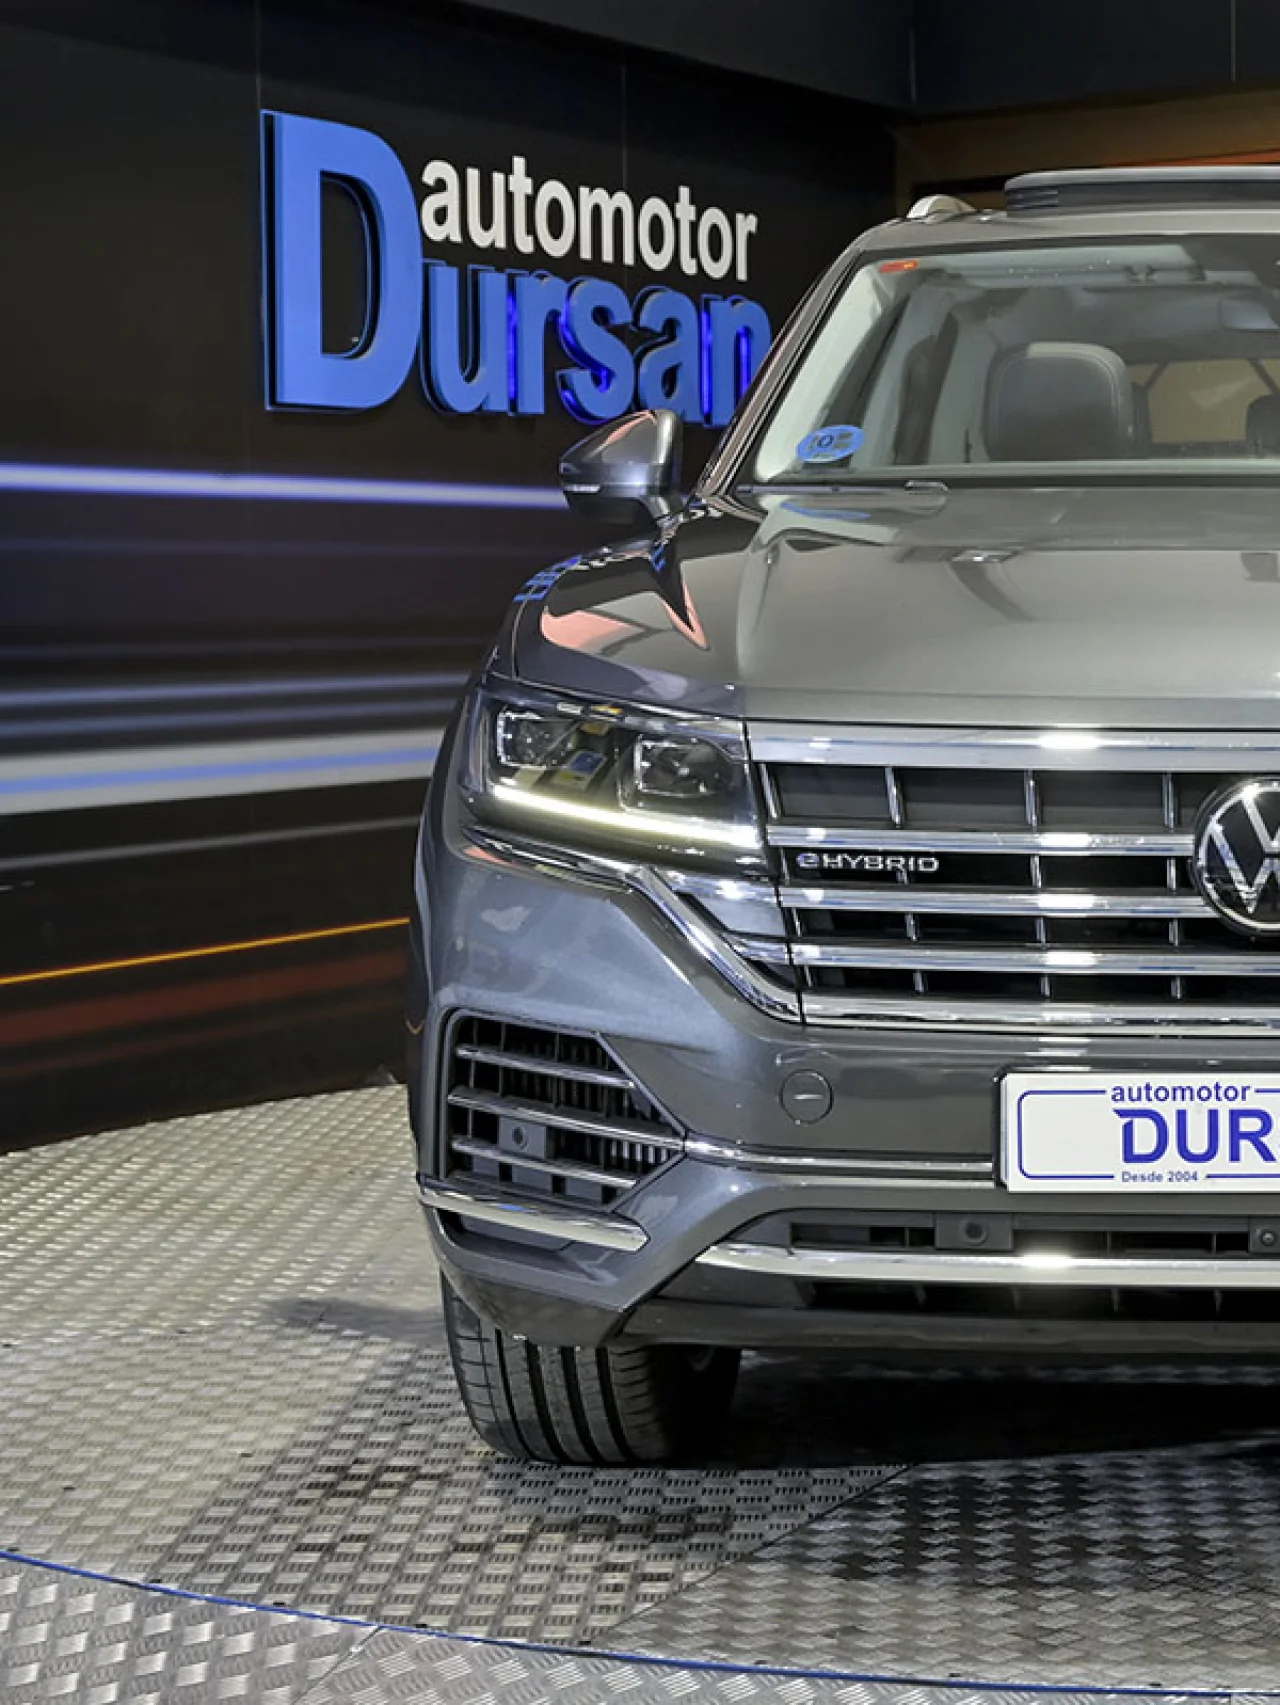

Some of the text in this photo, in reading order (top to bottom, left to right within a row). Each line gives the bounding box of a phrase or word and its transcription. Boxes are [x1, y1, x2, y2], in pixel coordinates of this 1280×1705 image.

[420, 155, 758, 281] automotor
[260, 109, 772, 428] Dursan
[1111, 1081, 1251, 1102] automotor
[1121, 1170, 1199, 1183] Desde 2004
